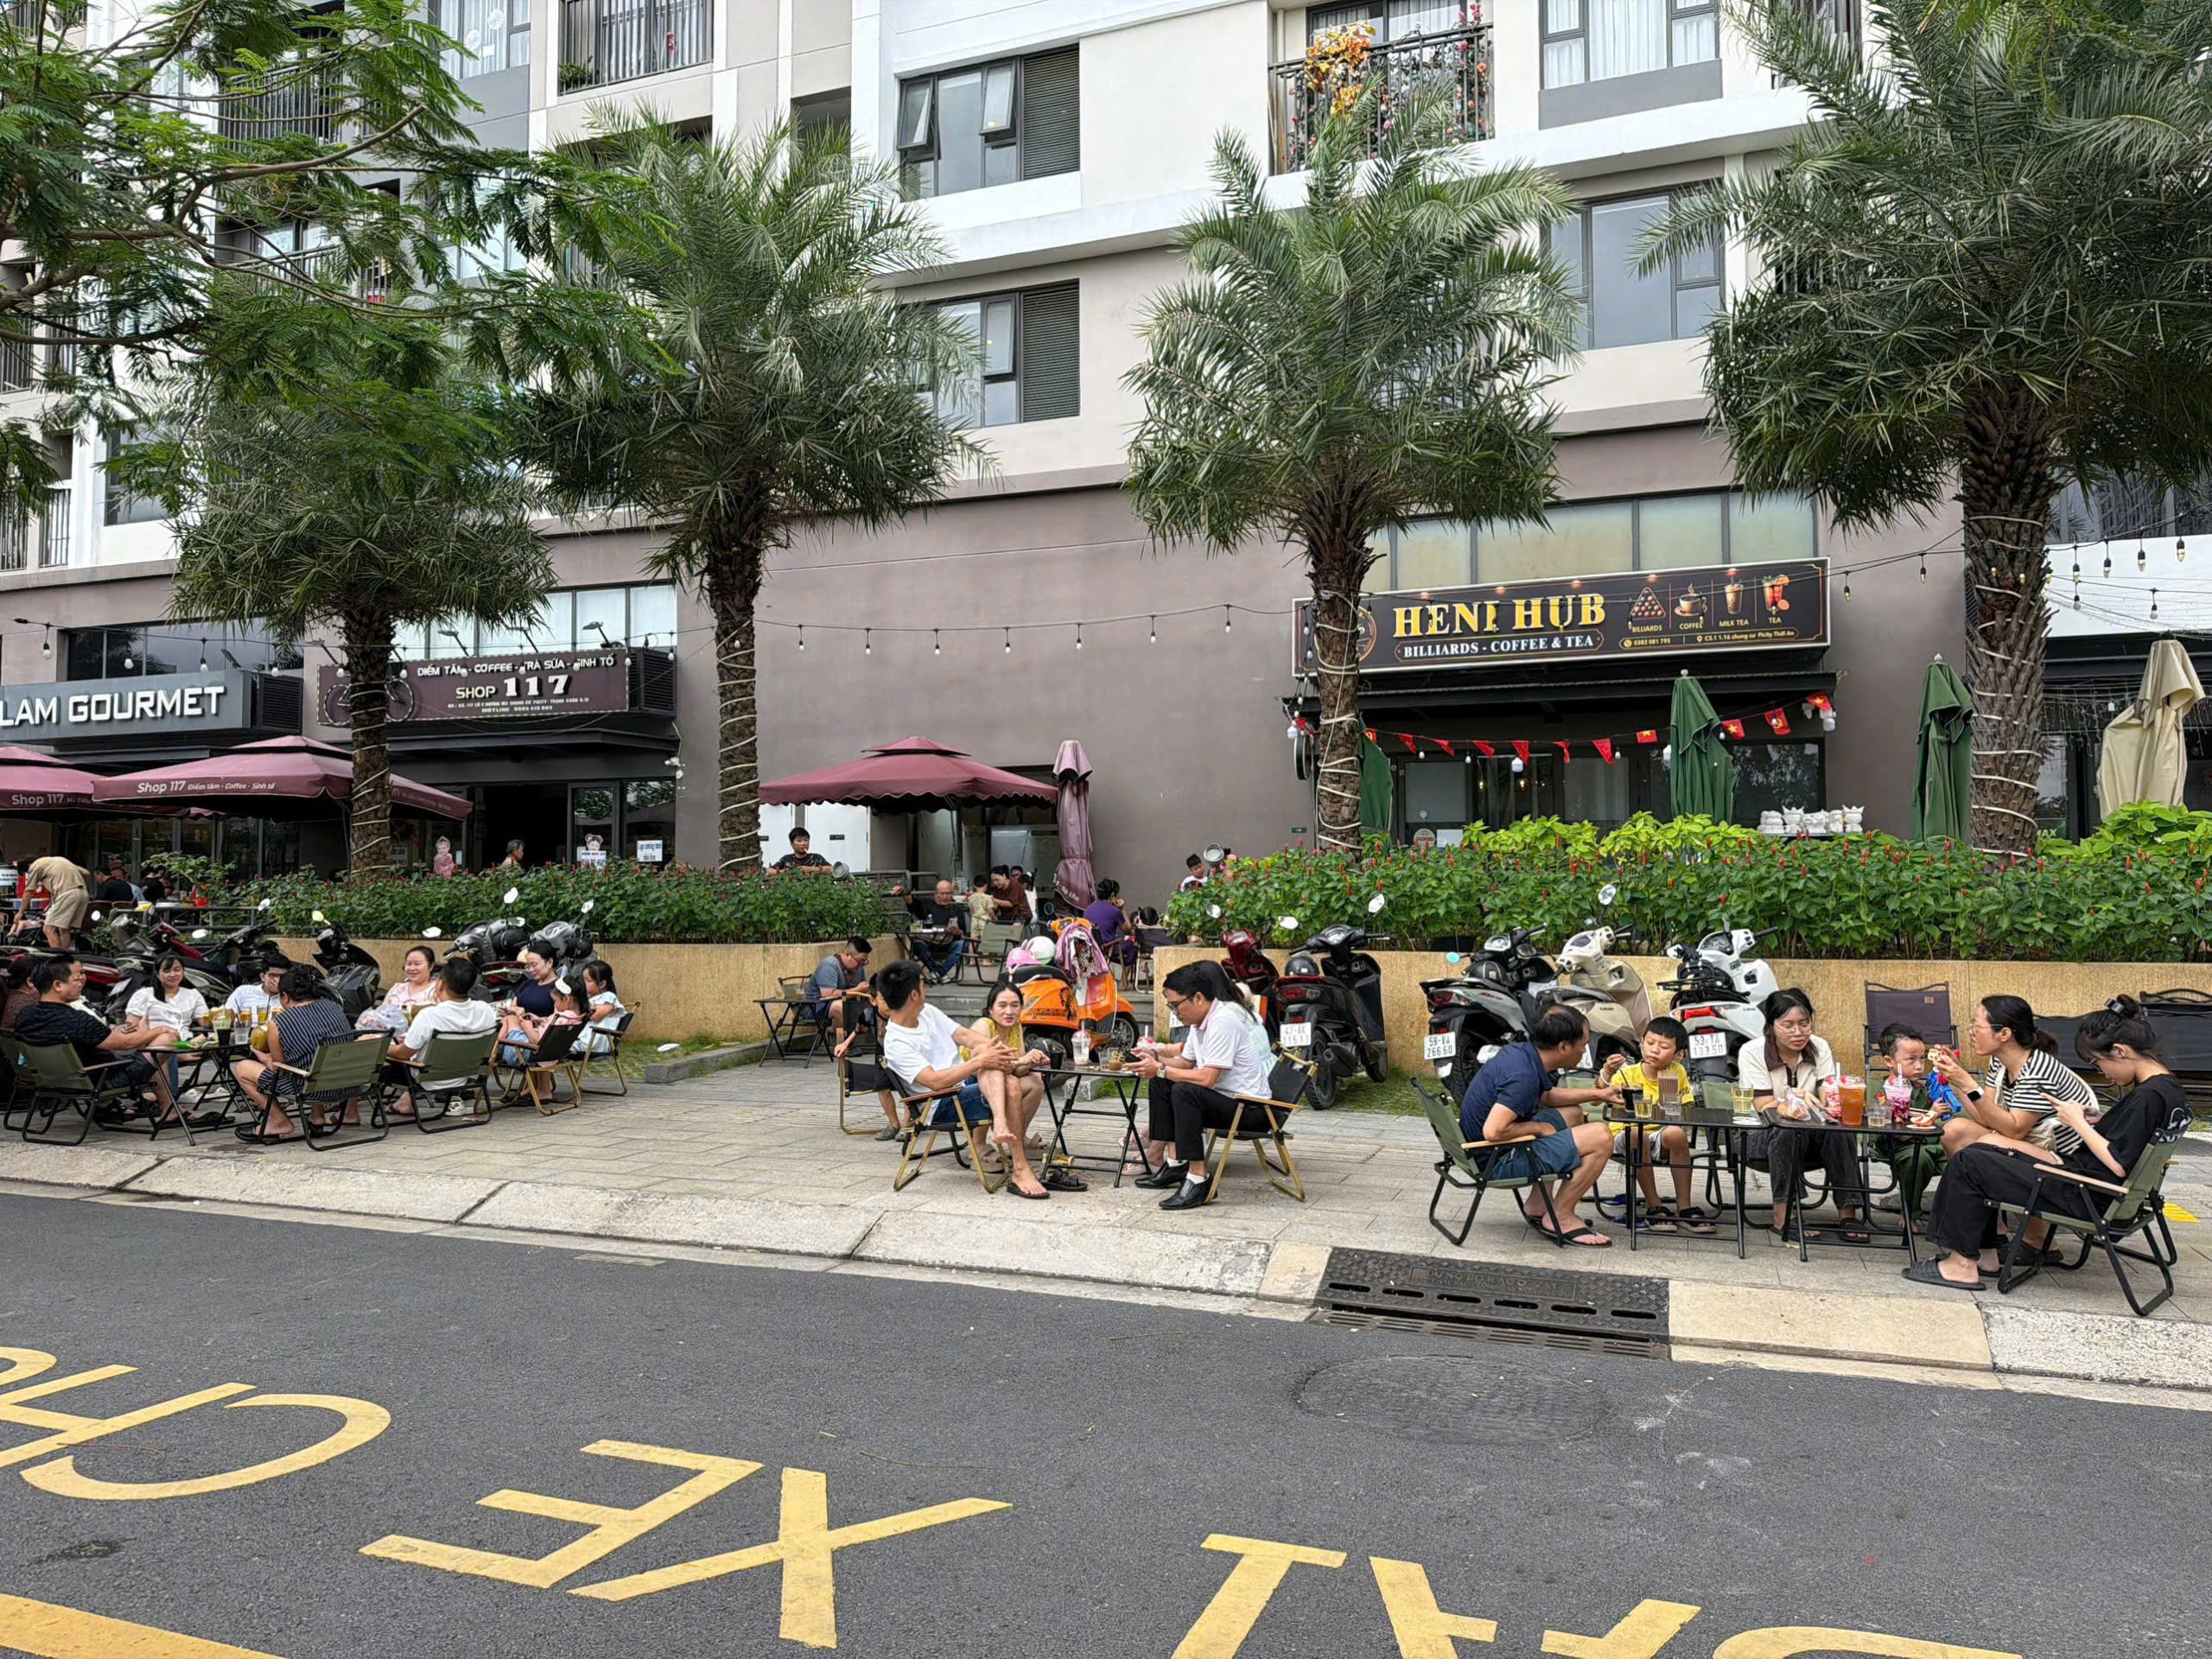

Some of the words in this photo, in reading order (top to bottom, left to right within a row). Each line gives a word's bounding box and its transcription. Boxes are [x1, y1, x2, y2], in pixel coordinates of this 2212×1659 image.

[1393, 601, 1500, 638] HENI
[1513, 594, 1606, 630] HUB
[1631, 625, 1663, 633] BILLIARDS
[1403, 642, 1478, 658] BILLIARDS
[1491, 638, 1549, 652] COFFEE
[1551, 637, 1561, 648] &
[1564, 635, 1594, 647] TEA
[474, 664, 513, 674] COFFEE
[455, 685, 496, 699] SHOP
[504, 674, 569, 697] 117
[0, 696, 57, 727] LAM
[68, 685, 225, 722] GOURMET
[137, 782, 167, 794] Shop
[169, 780, 187, 791] 117
[11, 794, 45, 806] Shop
[47, 793, 64, 804] 117
[1428, 1035, 1451, 1046] 59-VA
[359, 1438, 1013, 1649] XE
